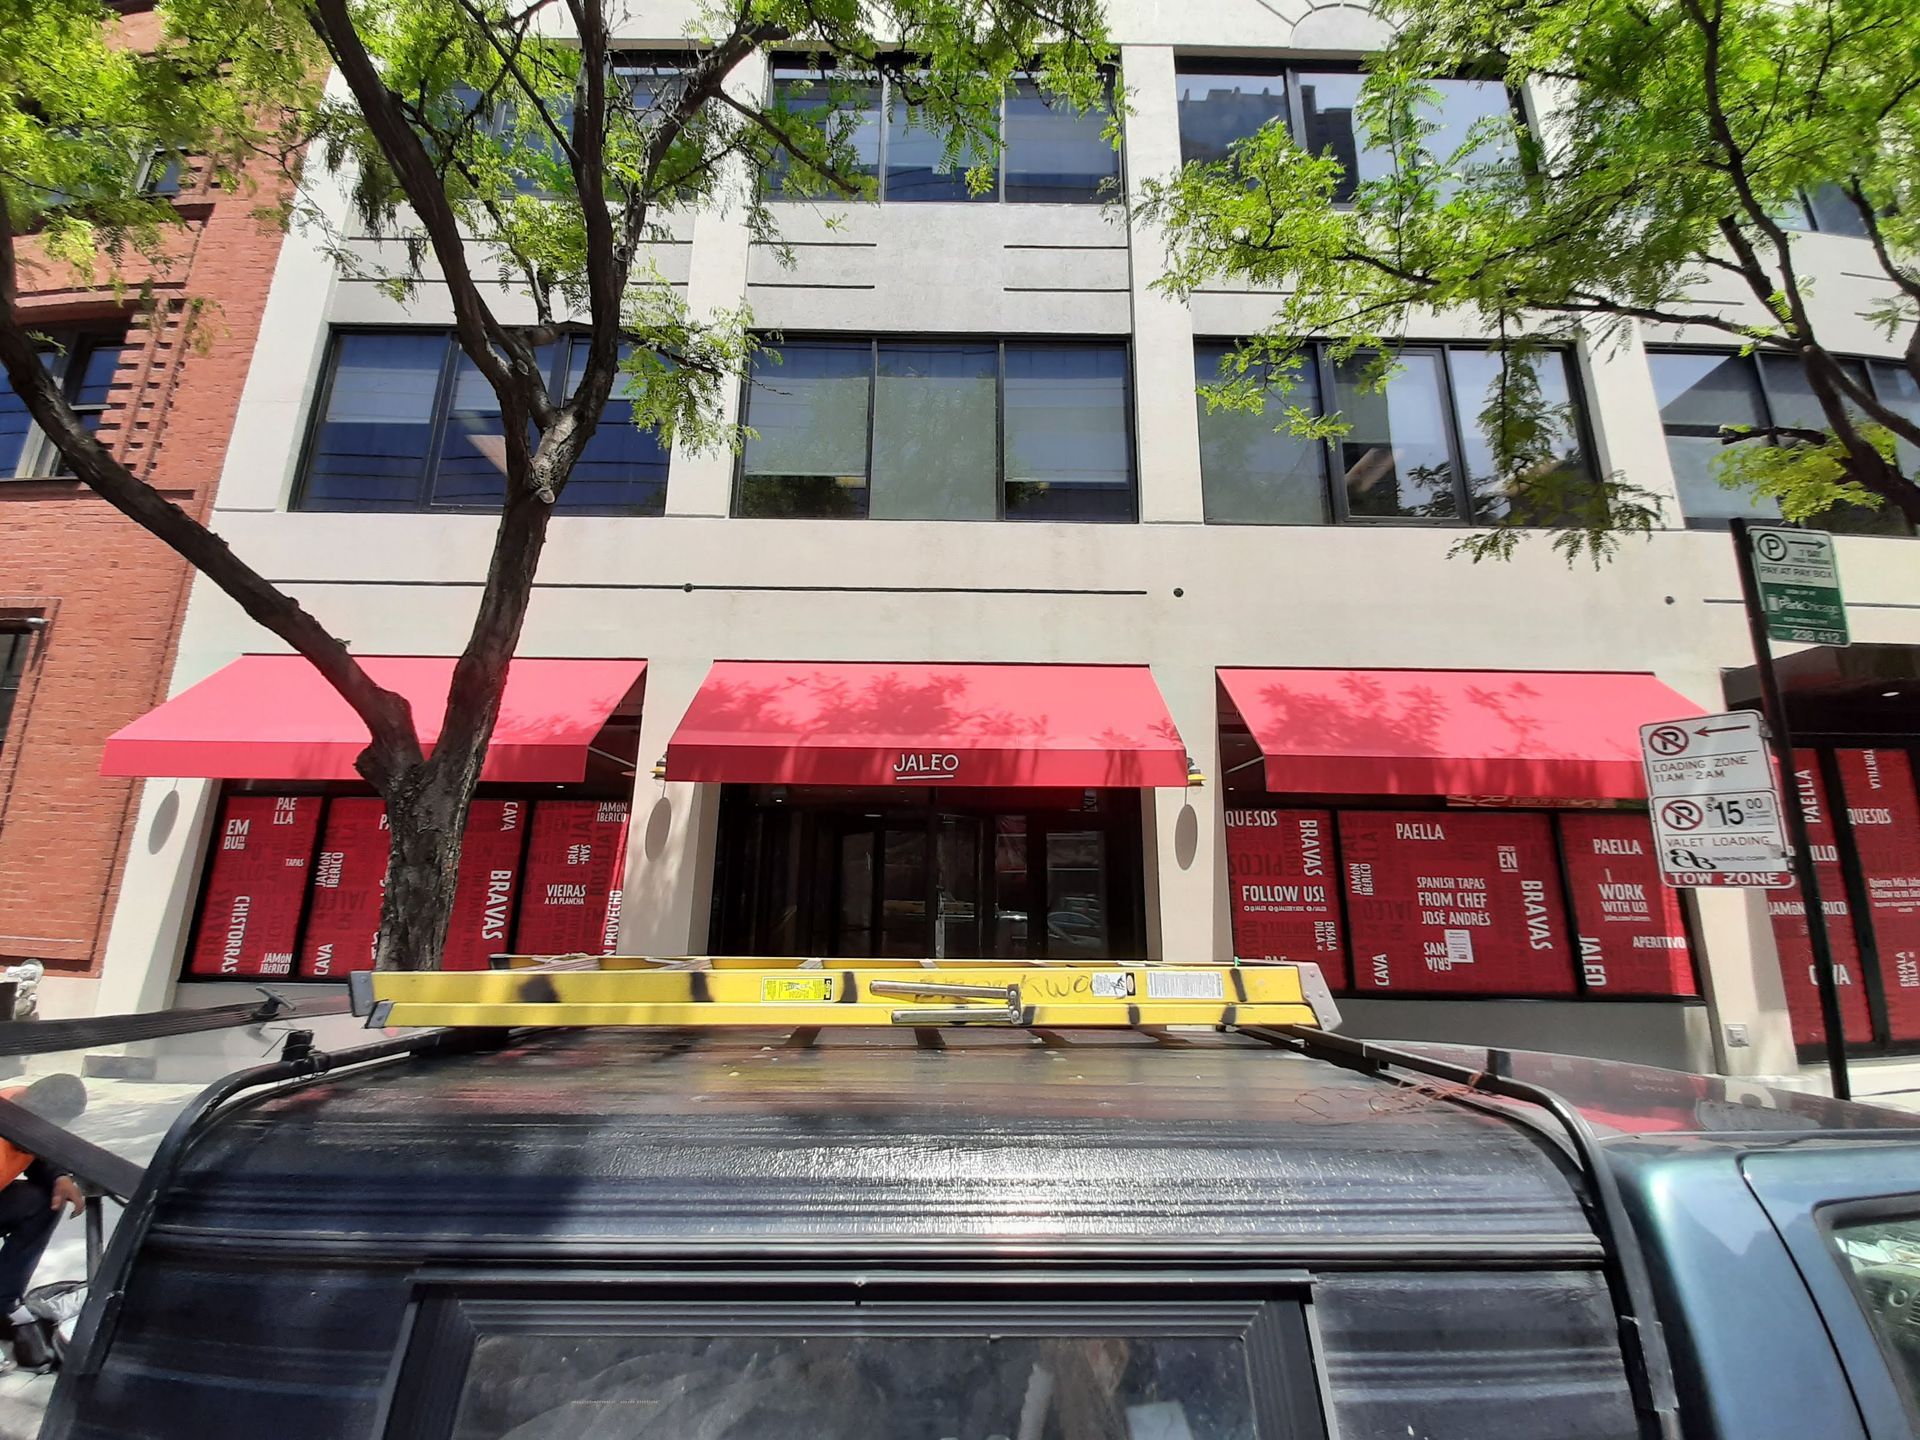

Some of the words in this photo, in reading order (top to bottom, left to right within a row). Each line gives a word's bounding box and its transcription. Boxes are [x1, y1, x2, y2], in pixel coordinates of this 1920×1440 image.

[893, 754, 959, 772] JALEO
[1653, 759, 1706, 773] LOADING
[1714, 756, 1749, 767] ZONE
[275, 797, 298, 811] PAE
[1794, 769, 1822, 823] PAELLA
[272, 811, 294, 825] LLA
[500, 801, 519, 832] CAVA
[1225, 810, 1278, 827] QUESOS
[1846, 808, 1892, 826] QUESOS
[226, 819, 250, 835] EM
[1395, 823, 1446, 840] PAELLA
[1299, 819, 1323, 876] BRAVAS
[1593, 838, 1643, 855] PAELLA
[1665, 838, 1704, 847] VALET
[1712, 835, 1770, 846] LOADING
[1498, 852, 1518, 868] EN
[1416, 877, 1455, 889] SPANISH
[1456, 878, 1487, 889] TAPAS
[1670, 873, 1713, 885] TOW
[1723, 872, 1782, 885] ZONE
[546, 884, 587, 897] VIEIRAS
[1241, 885, 1298, 902] FOLLOW
[1303, 886, 1326, 902] US!
[1598, 883, 1646, 900] WORK
[481, 869, 512, 940] BRAVAS
[1417, 891, 1454, 907] FROM
[1457, 892, 1488, 908] CHEF
[1601, 901, 1630, 913] WITH
[604, 889, 623, 947] PROVECHO
[1520, 880, 1553, 950] BRAVAS
[220, 895, 251, 974] CHISTORRAS
[1325, 921, 1337, 952] ENSALA
[314, 943, 334, 976] CAVA
[1578, 935, 1607, 986] JALEO
[1373, 953, 1391, 986] CAVA
